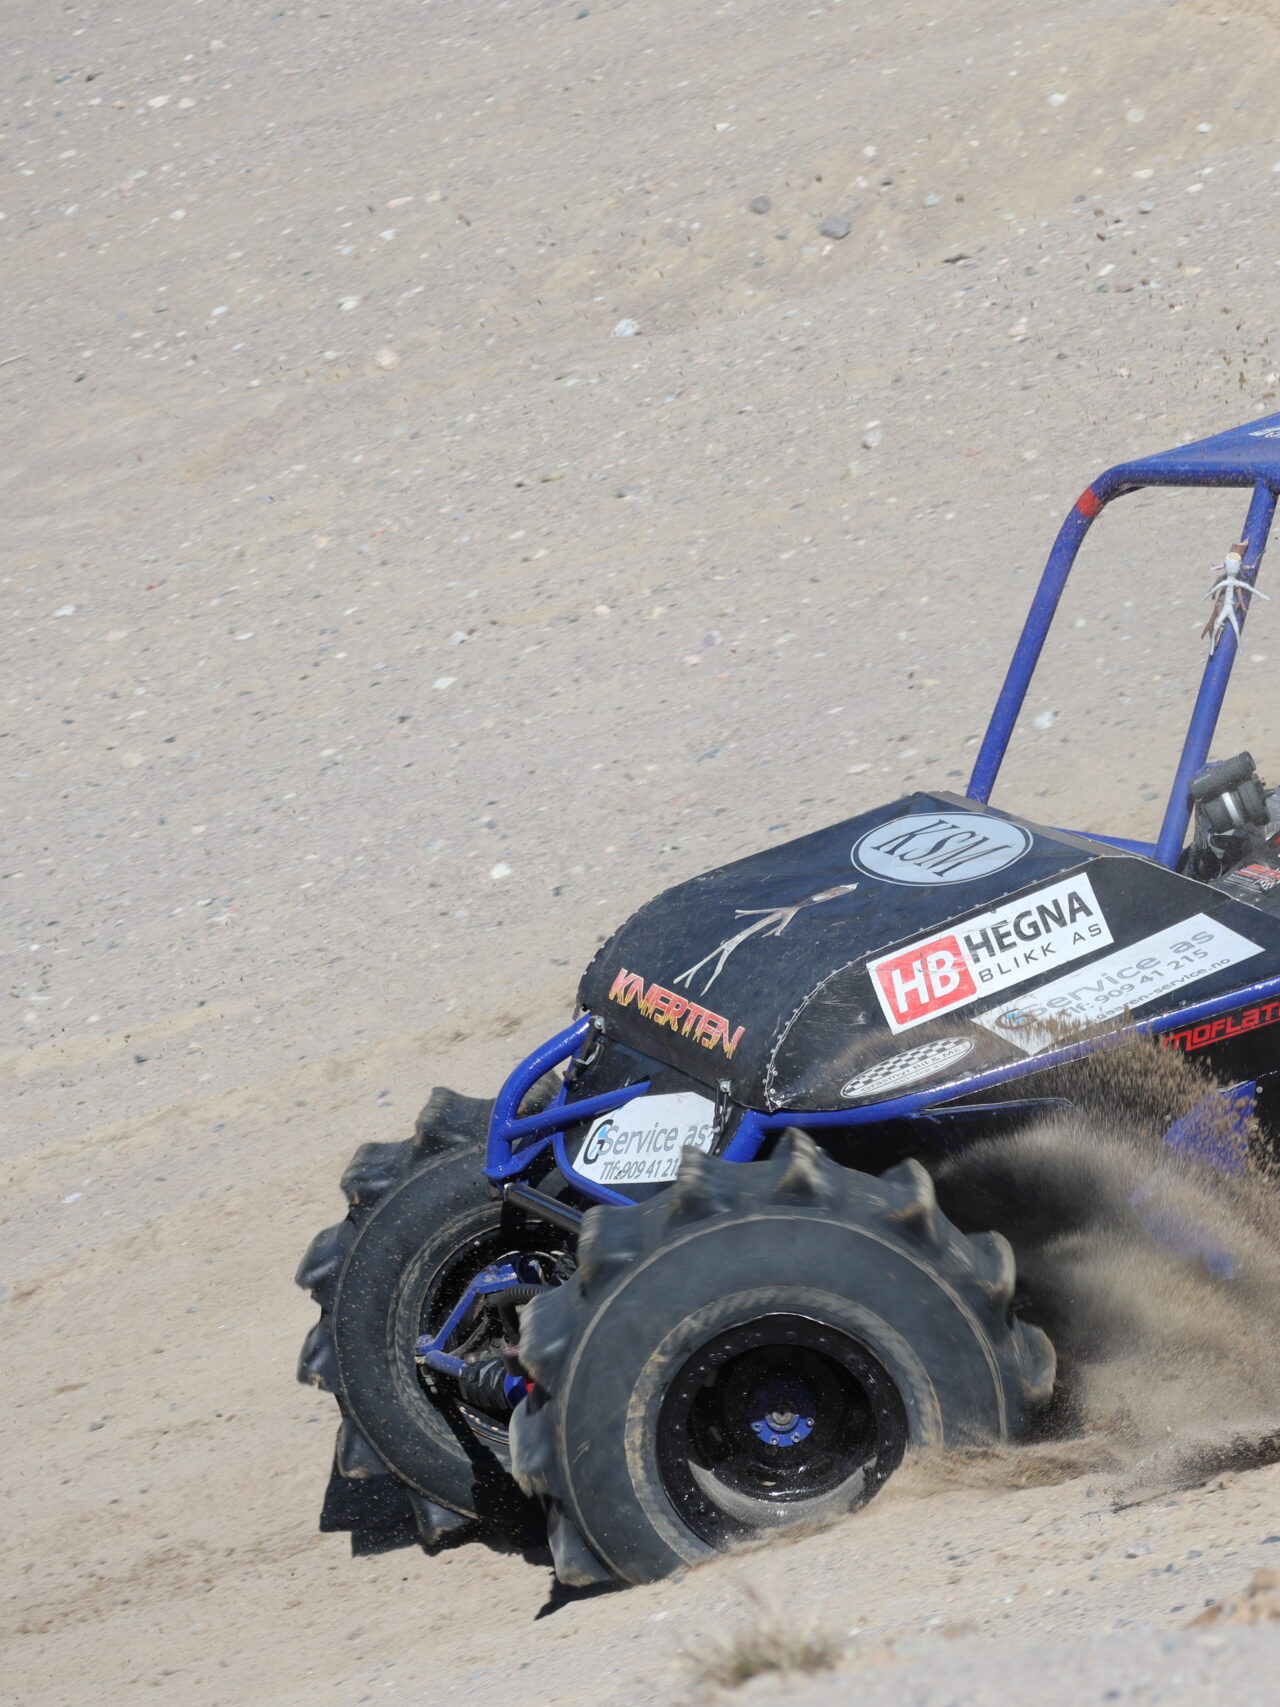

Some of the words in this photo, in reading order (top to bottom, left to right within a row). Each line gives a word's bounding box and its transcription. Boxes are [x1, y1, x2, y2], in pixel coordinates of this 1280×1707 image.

[870, 819, 1013, 878] KSM
[963, 891, 1094, 965] HEGNA
[979, 942, 1056, 984] BLIKK
[1072, 923, 1102, 946] AS
[1169, 930, 1216, 955] as
[891, 950, 961, 1014] HB
[1094, 982, 1135, 1006] 909
[1140, 969, 1164, 985] 41
[1167, 949, 1209, 971] 215
[608, 968, 746, 1060] KNERTEN
[646, 1161, 662, 1180] 41
[661, 1158, 680, 1178] 21
